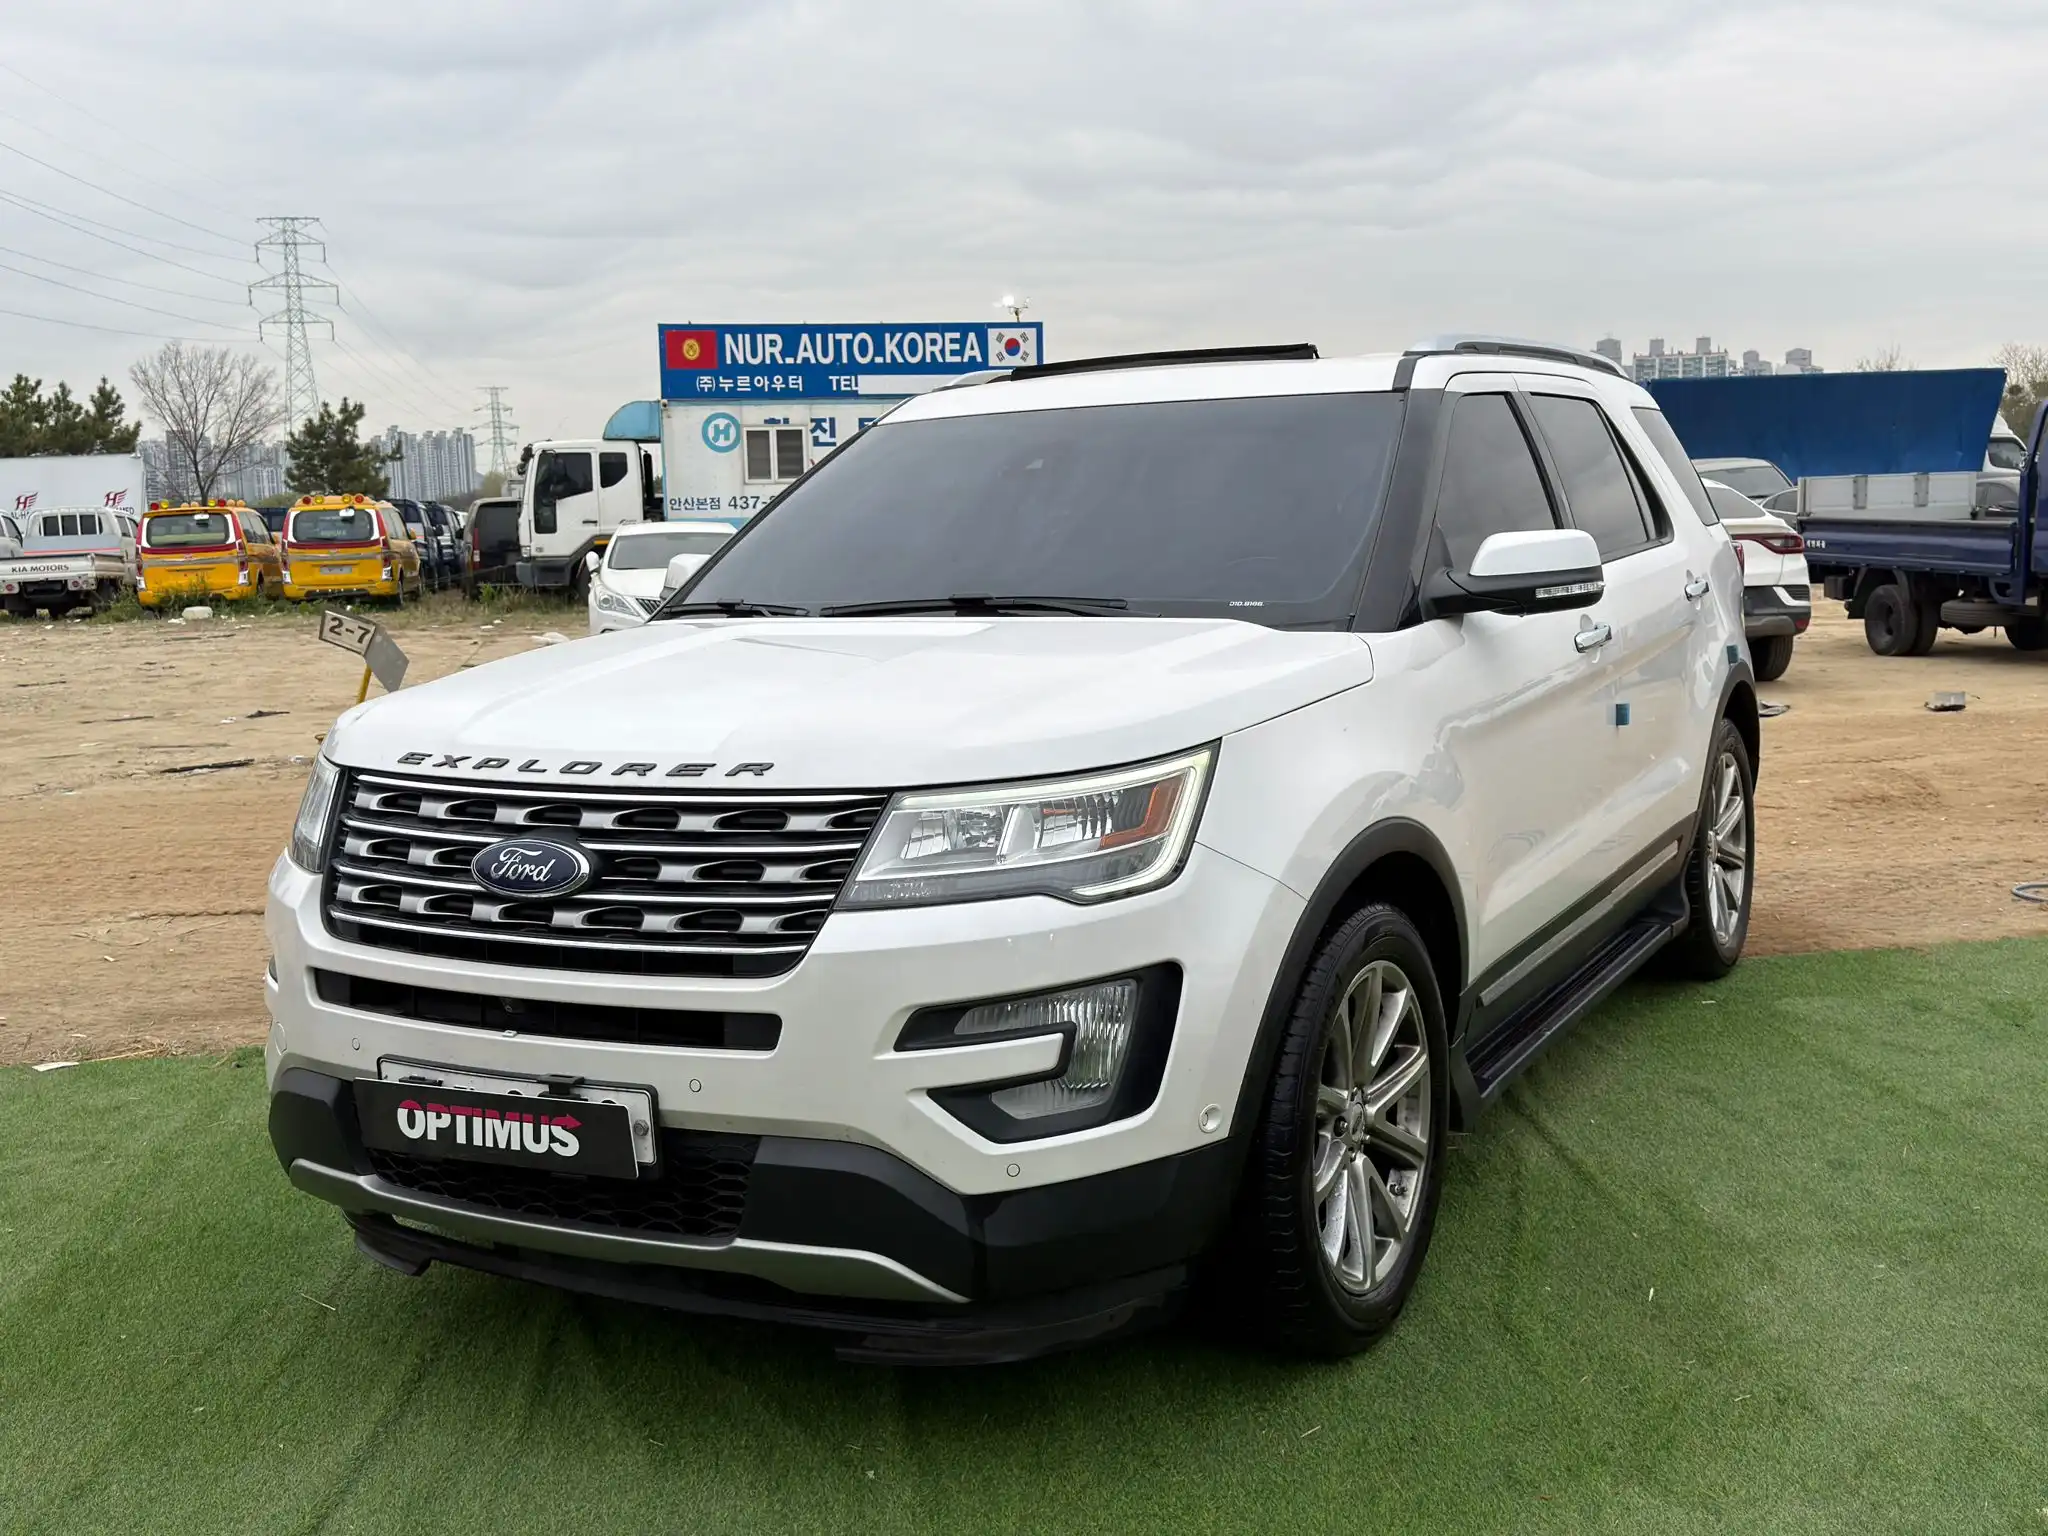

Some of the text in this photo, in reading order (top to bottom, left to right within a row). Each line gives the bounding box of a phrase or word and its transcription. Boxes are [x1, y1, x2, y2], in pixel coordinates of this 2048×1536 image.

[828, 375, 859, 391] TEL
[669, 496, 721, 511] 안산본점
[11, 564, 70, 573] KIA MOTORS
[329, 616, 371, 644] 2-7
[397, 751, 775, 777] EXPLORER
[490, 847, 555, 883] Ford
[397, 1099, 580, 1157] OPTIMUS
